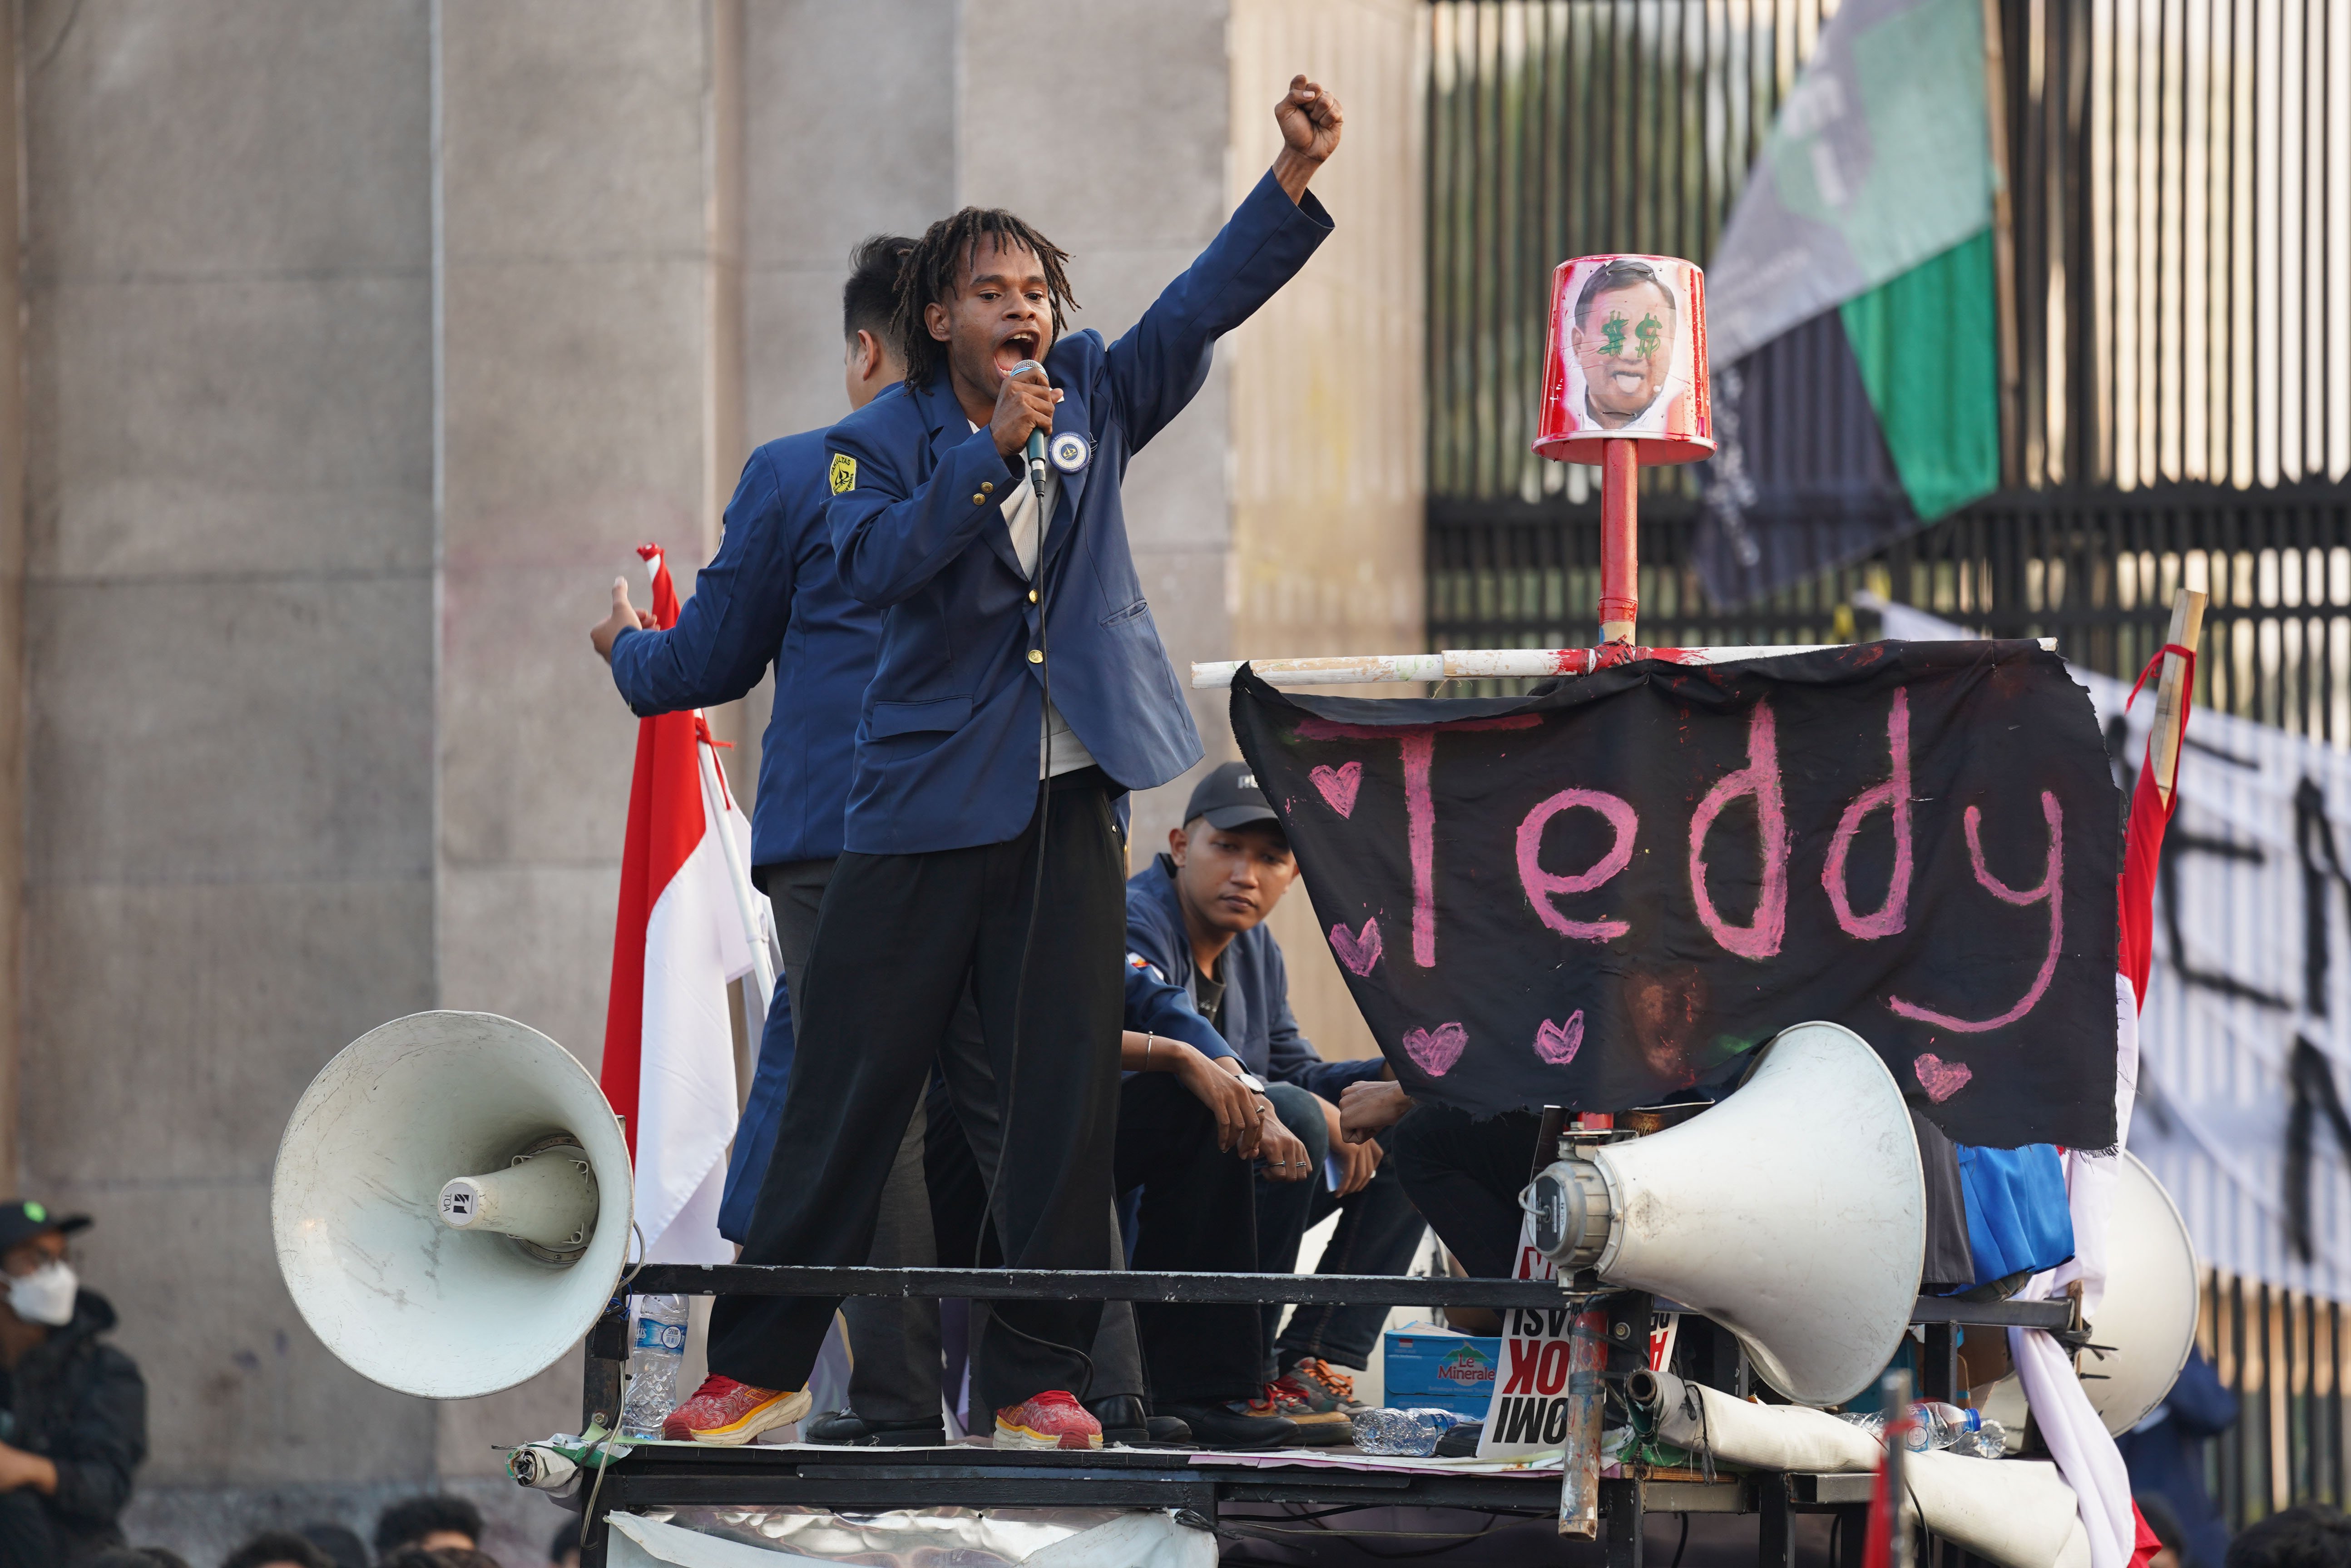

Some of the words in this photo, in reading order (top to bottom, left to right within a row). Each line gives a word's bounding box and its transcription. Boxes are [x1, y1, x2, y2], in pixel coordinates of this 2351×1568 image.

[831, 456, 851, 476] FAKULTAS
[1293, 685, 2064, 1033] Teddy
[443, 1193, 452, 1212] TOA
[1459, 1354, 1475, 1367] Le
